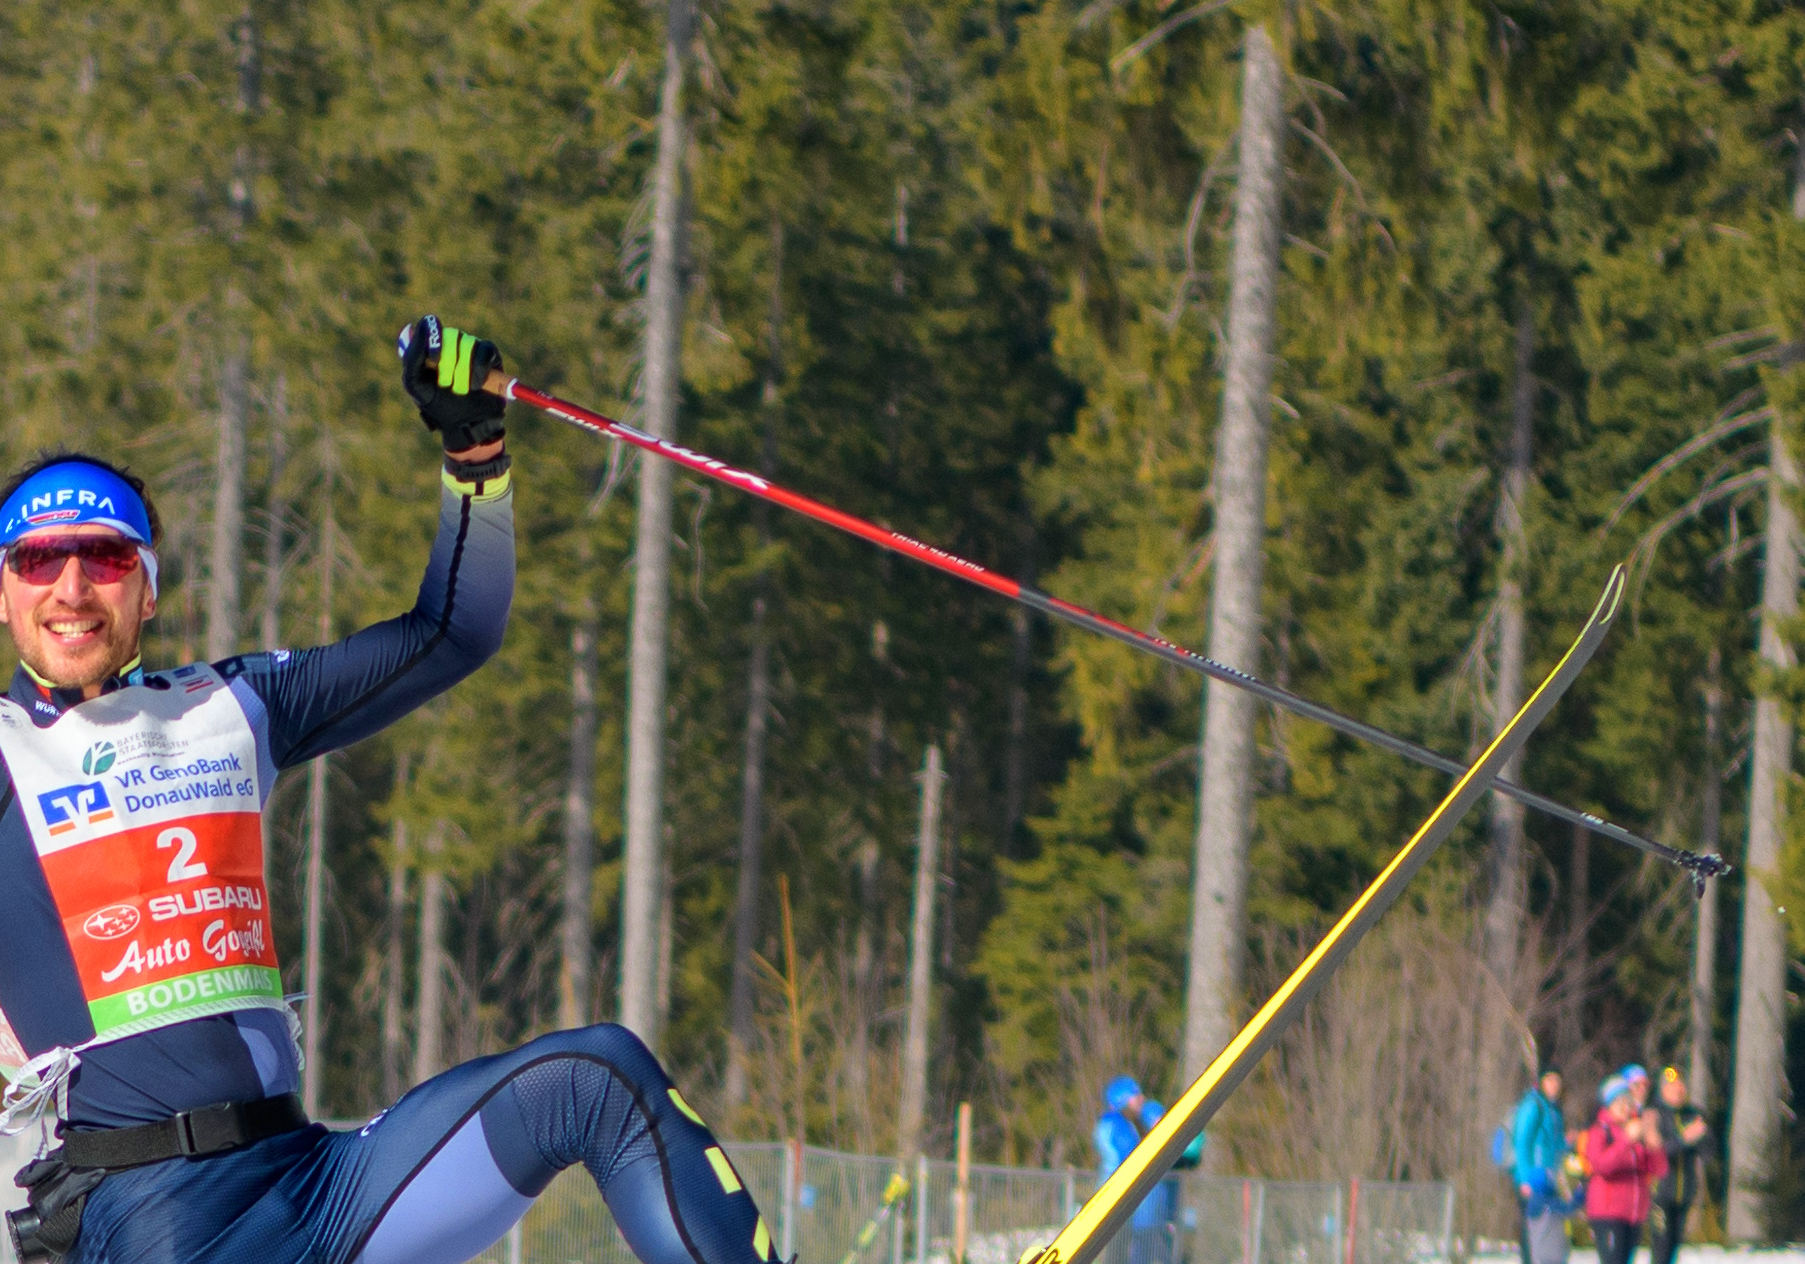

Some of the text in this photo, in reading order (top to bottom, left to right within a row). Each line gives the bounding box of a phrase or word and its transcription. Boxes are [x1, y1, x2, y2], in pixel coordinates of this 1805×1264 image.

[115, 768, 146, 789] VR
[150, 752, 242, 782] GenoBank
[124, 777, 254, 813] DonauWald eG
[156, 826, 208, 884] 2
[148, 886, 262, 921] SUBARU
[101, 937, 191, 983] Auto
[125, 968, 273, 1016] BODENMAIS
